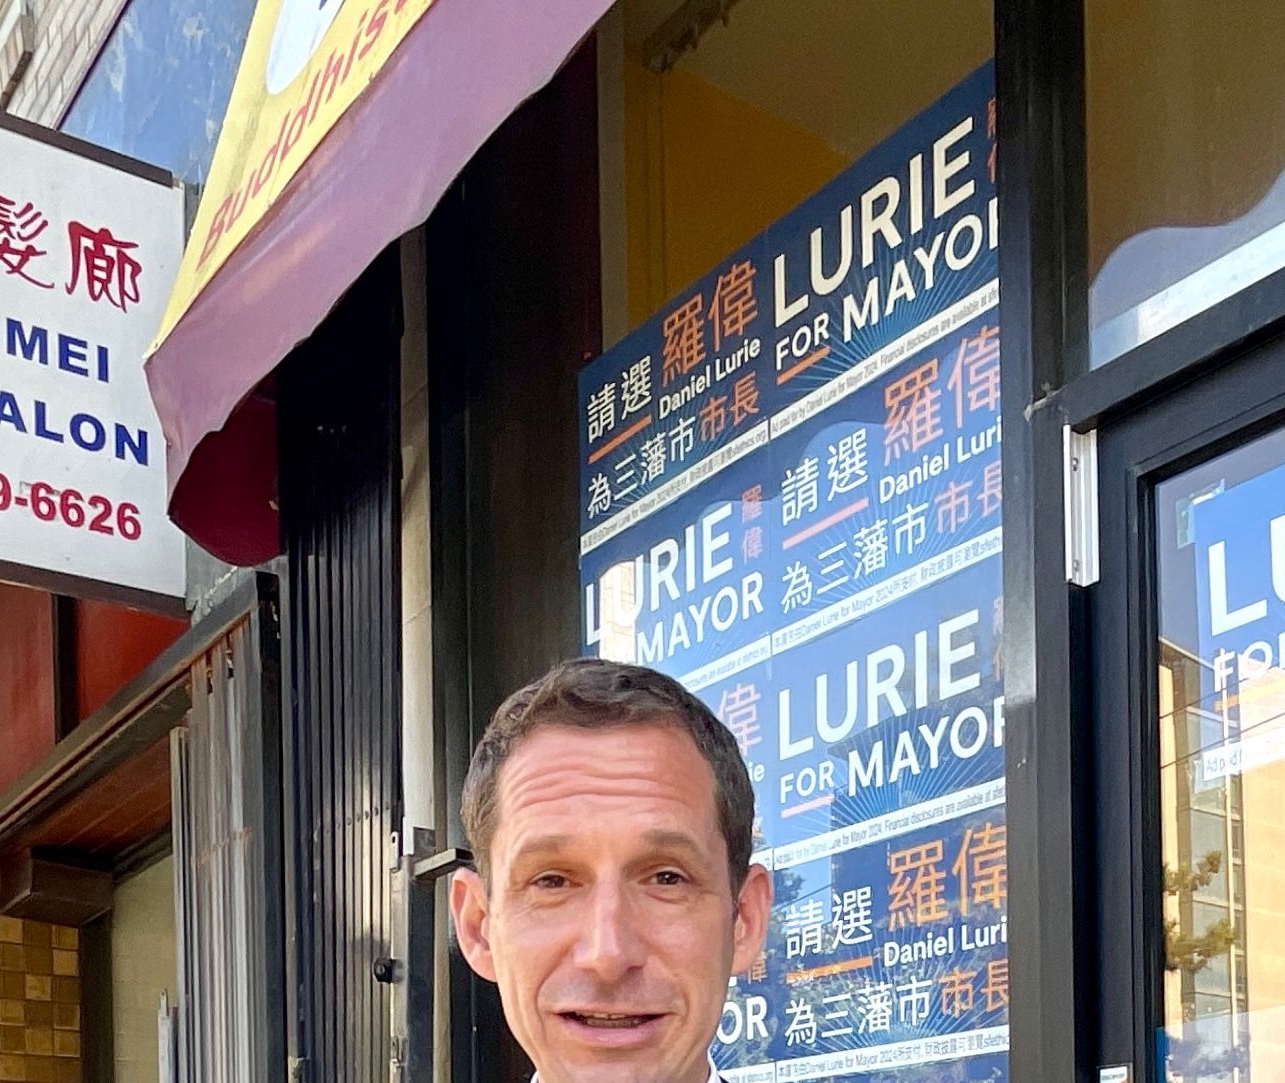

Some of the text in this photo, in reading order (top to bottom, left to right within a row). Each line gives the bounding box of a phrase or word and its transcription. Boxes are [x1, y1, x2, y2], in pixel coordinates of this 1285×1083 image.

[196, 0, 408, 270] Buddhis
[773, 116, 976, 329] LURIE
[6, 316, 111, 383] MEI
[587, 259, 759, 444] 請選 羅偉
[658, 336, 761, 421] Daniel Lurie
[775, 313, 830, 372] FOR
[587, 371, 760, 519] 為三藩市市長
[780, 427, 868, 528] 請選
[883, 324, 1001, 467] 羅偉
[878, 417, 1002, 505] Daniel Luri
[781, 460, 1002, 615] 為三藩市市長
[636, 571, 764, 668] MAYOR
[717, 683, 763, 756] 偉
[779, 608, 981, 762] LURIE
[780, 760, 835, 804] FOR
[785, 821, 1006, 960] 請選 羅偉
[884, 916, 1006, 968] Daniel Luri
[717, 998, 767, 1045] OR
[784, 958, 1009, 1047] 為三藩市市長
